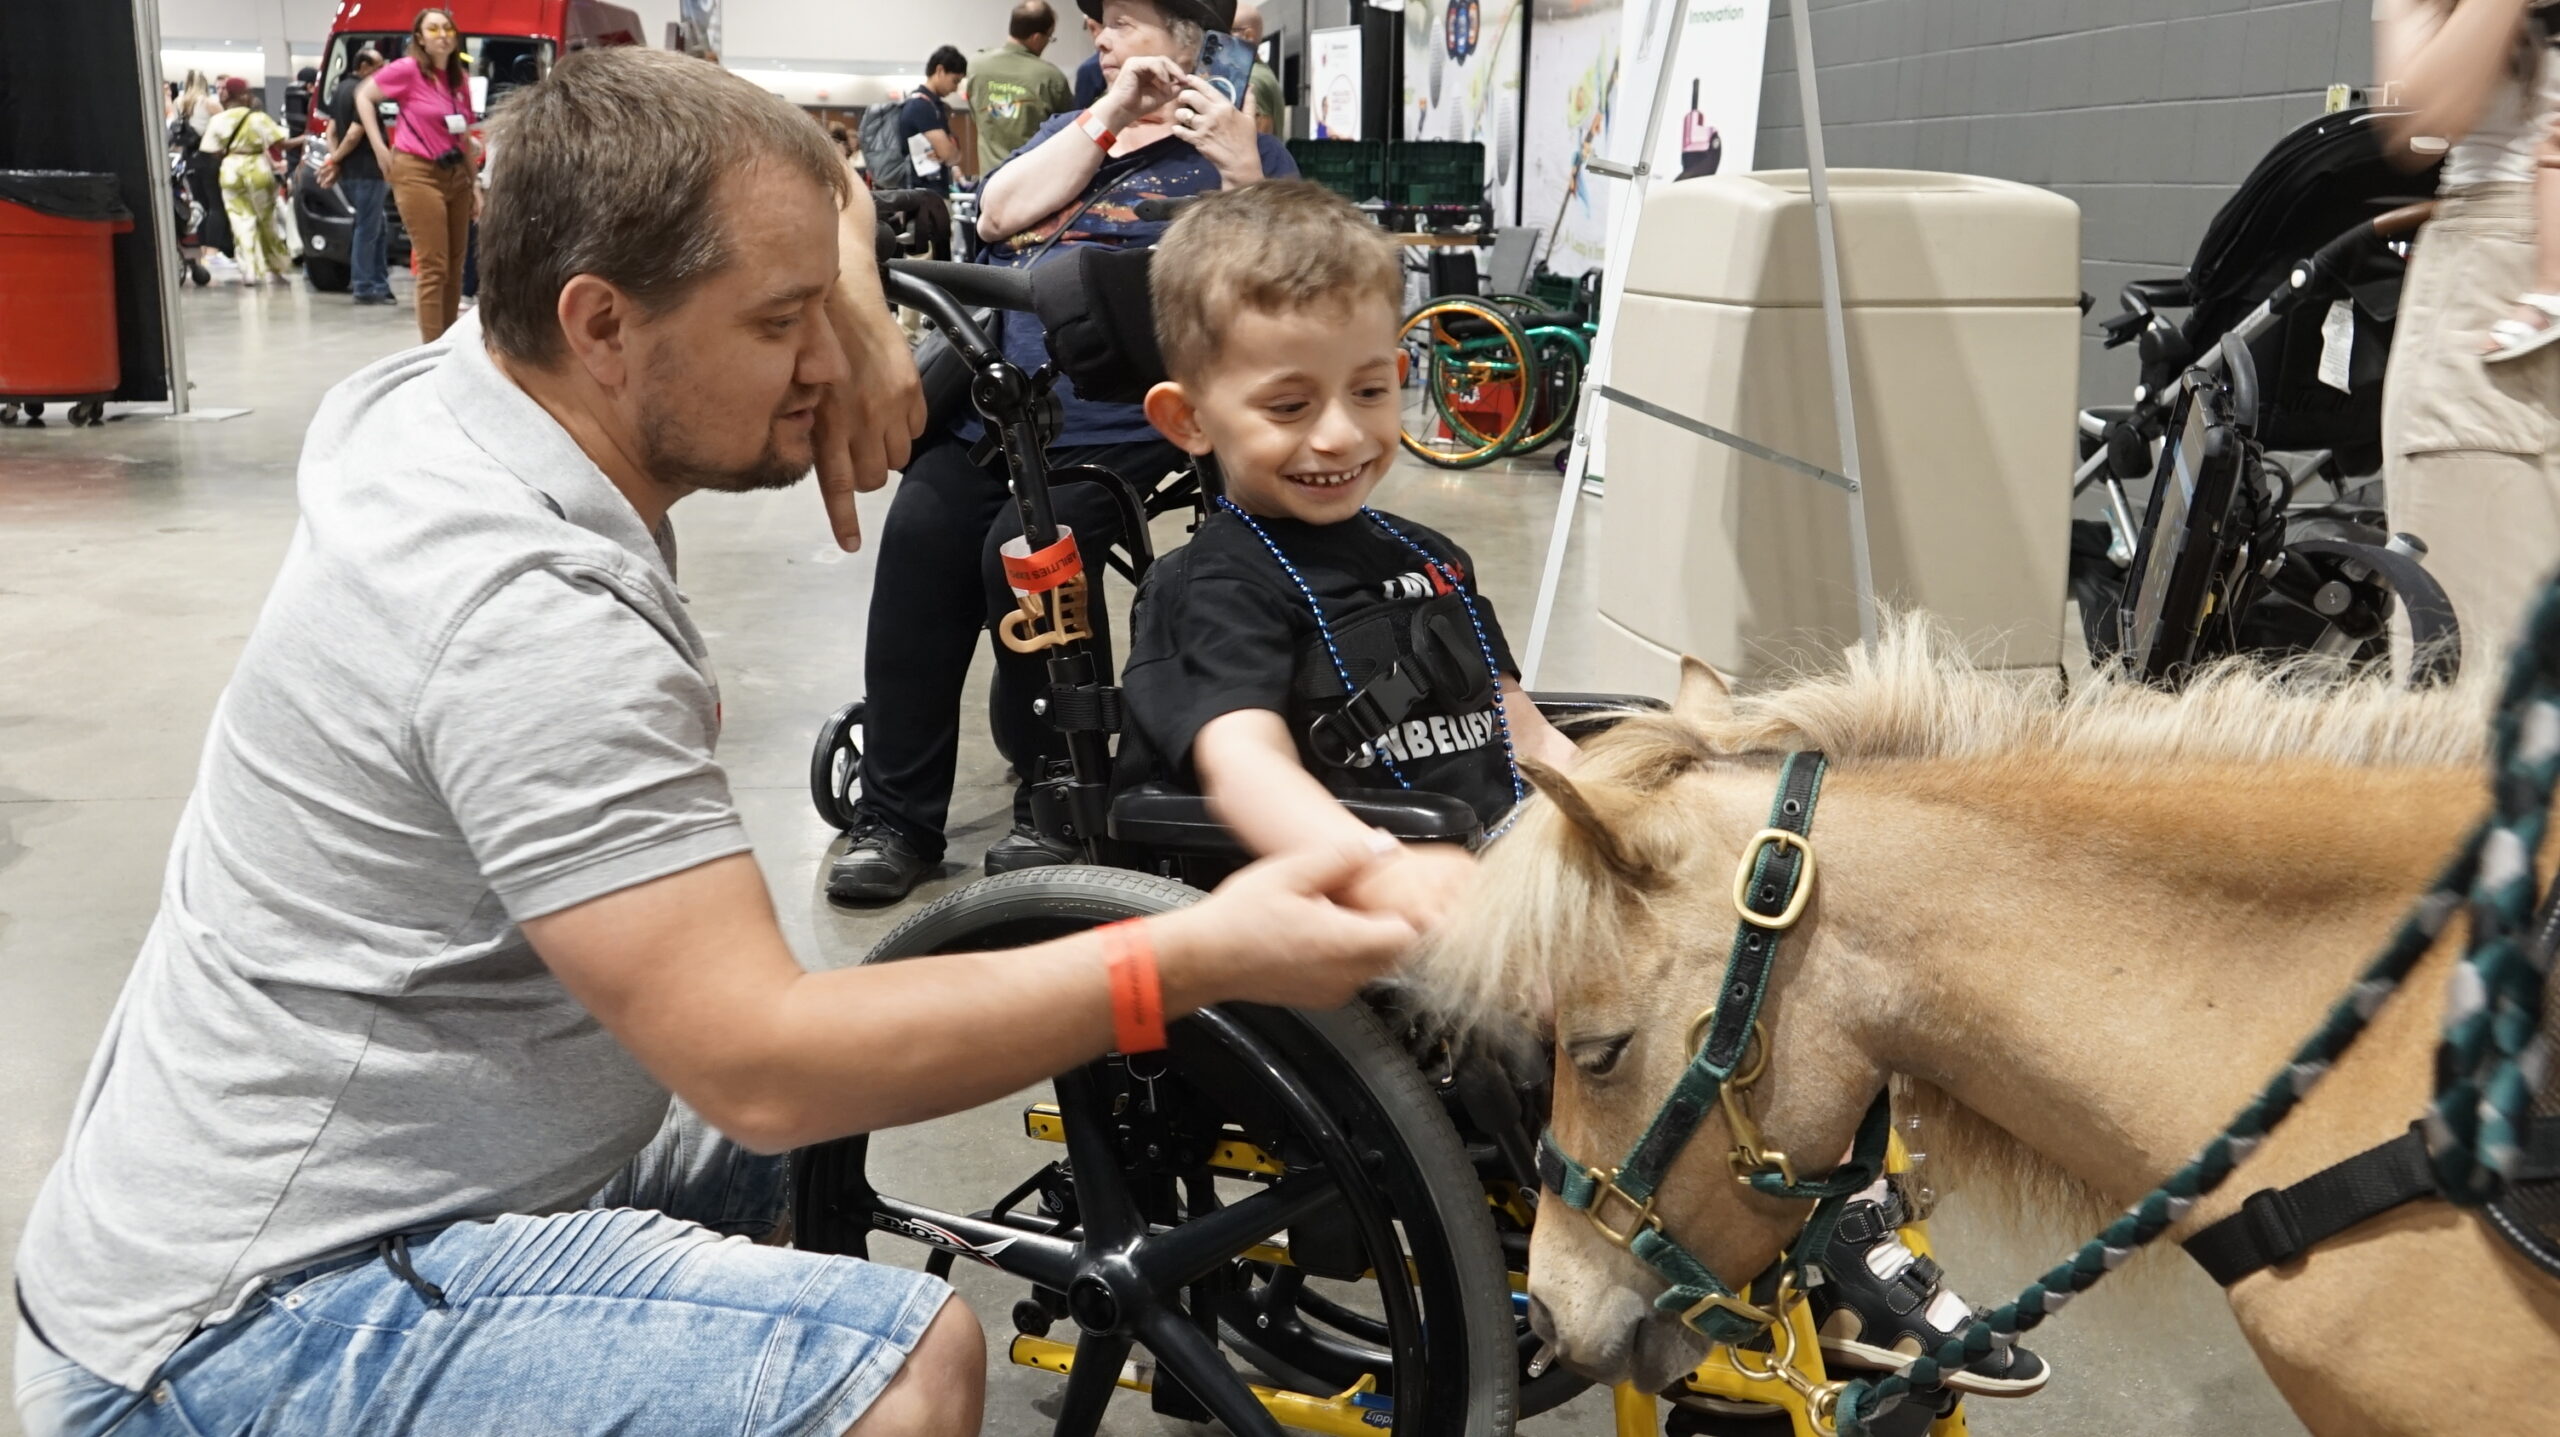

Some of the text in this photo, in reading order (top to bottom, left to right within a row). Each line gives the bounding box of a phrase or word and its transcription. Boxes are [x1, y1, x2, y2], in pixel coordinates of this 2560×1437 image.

[1689, 7, 1744, 24] Innovation
[1351, 710, 1493, 768] UNBELIEV
[1366, 1411, 1393, 1424] Zippi
